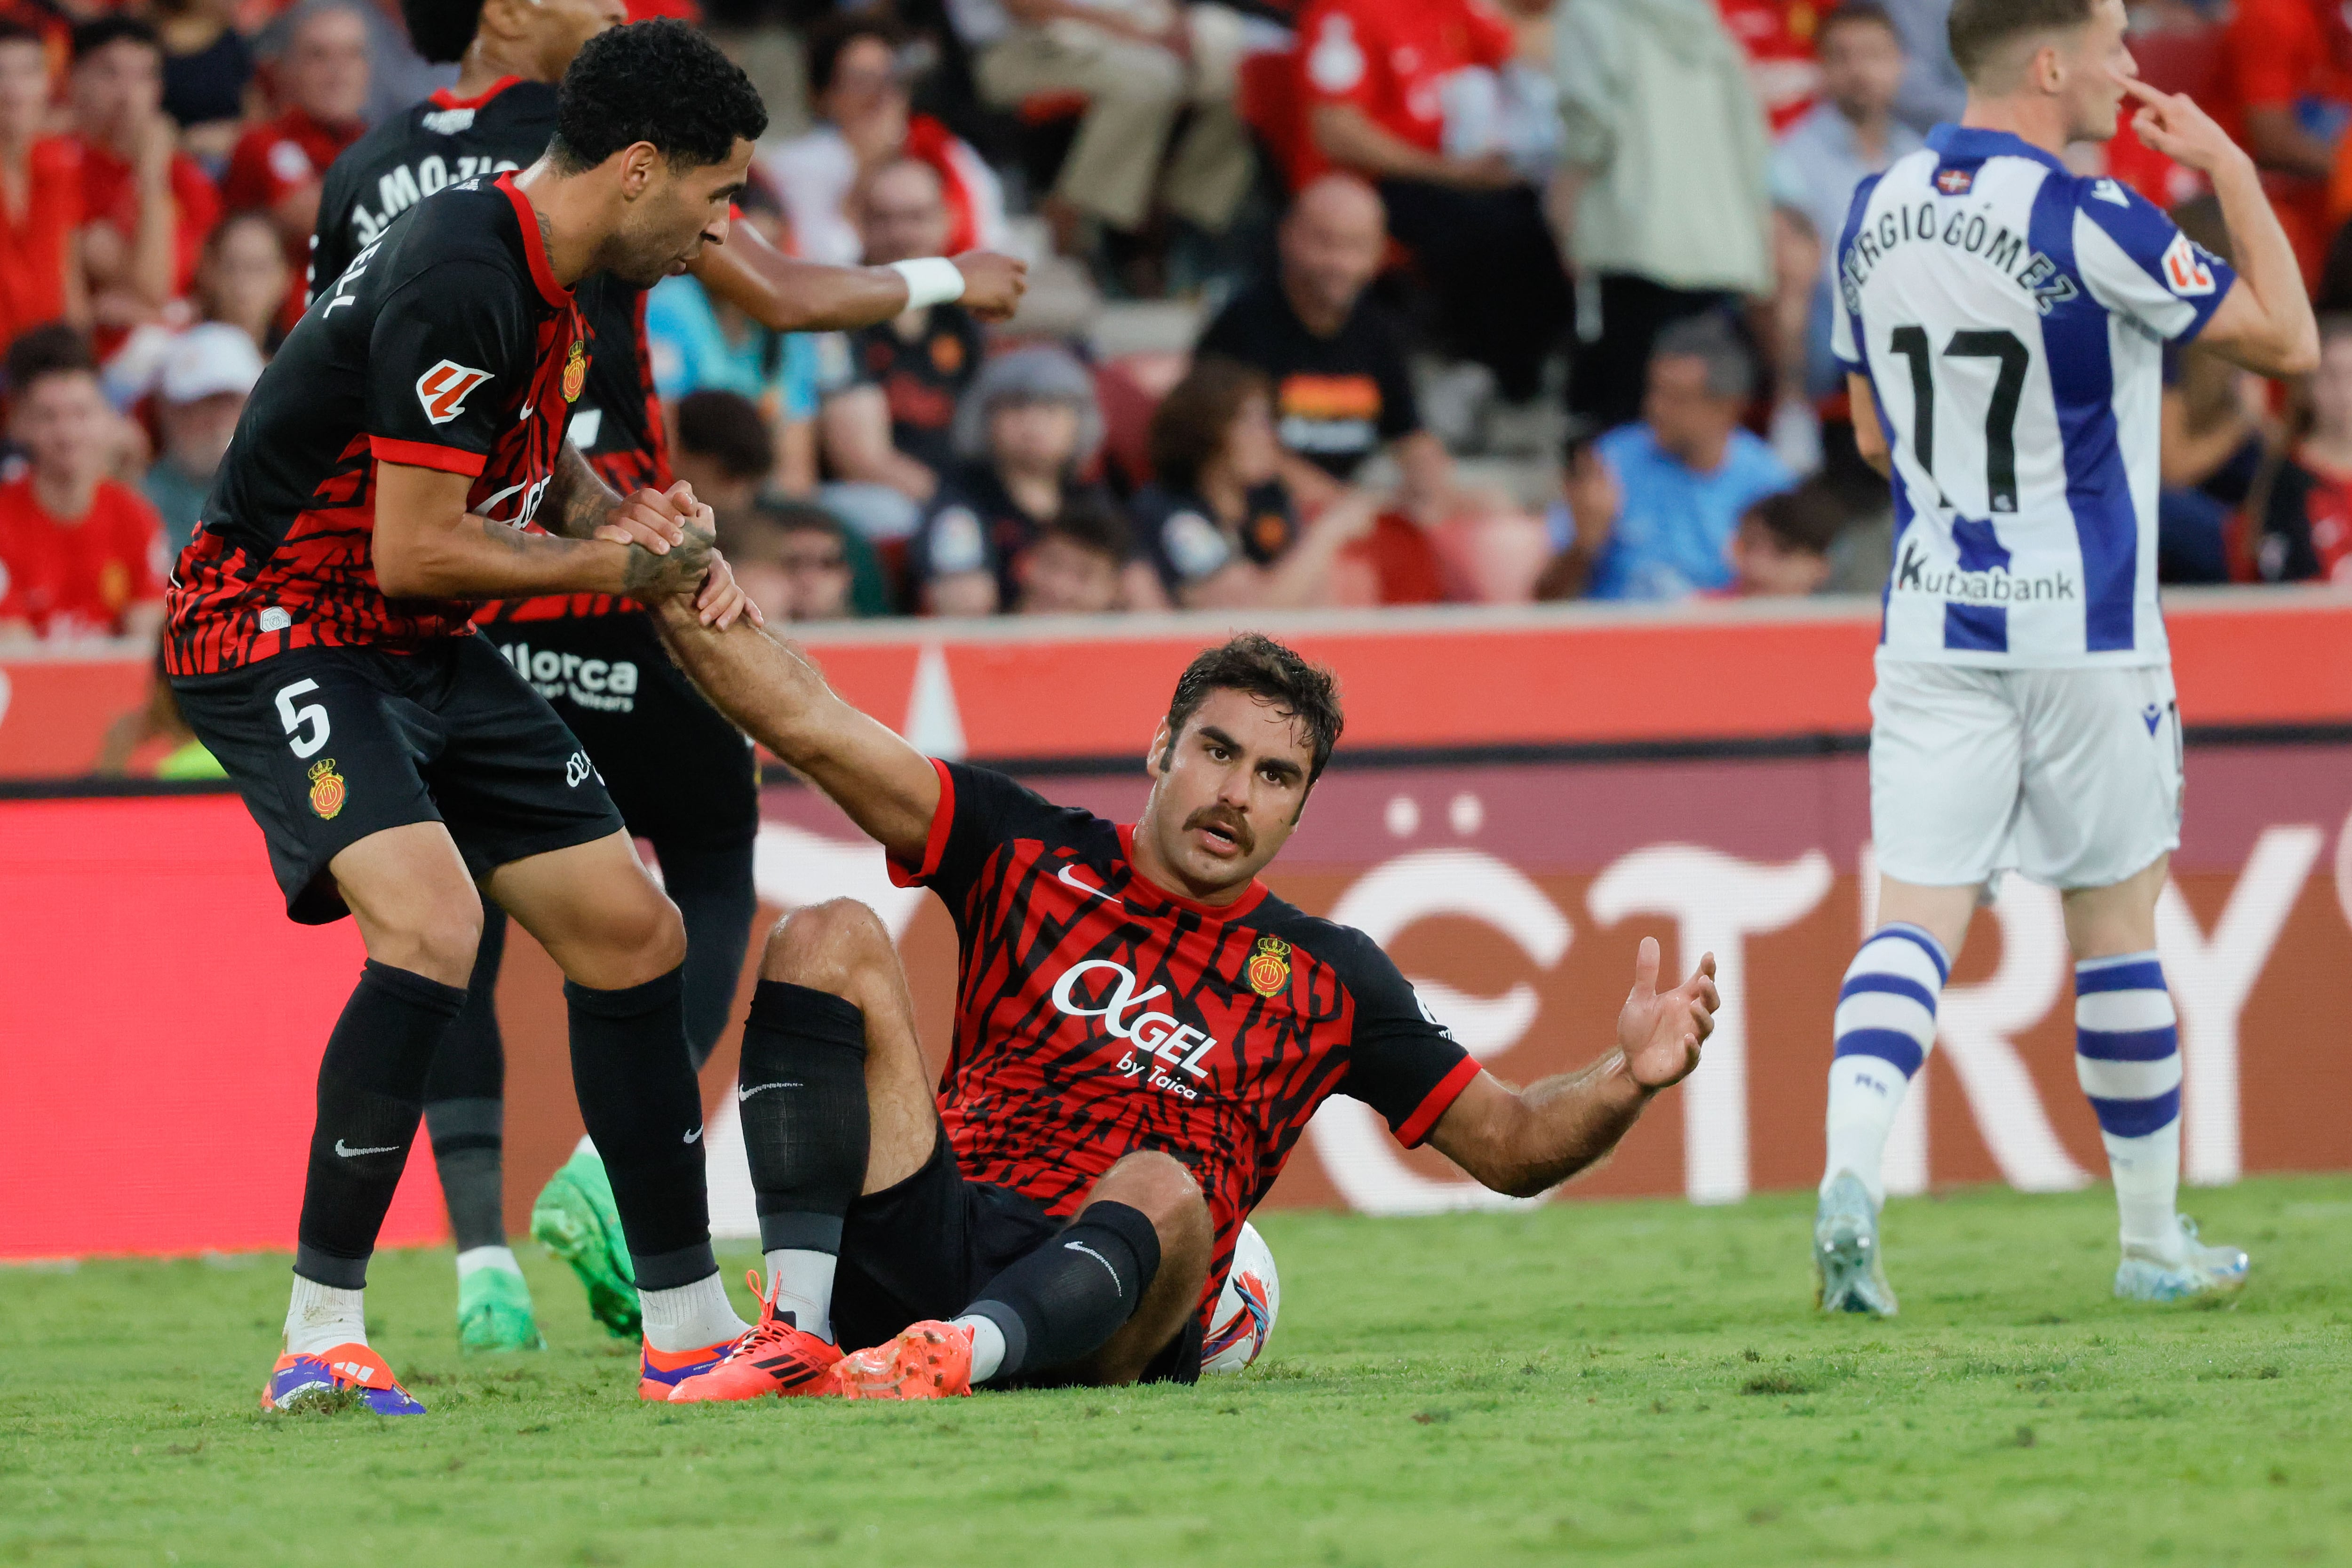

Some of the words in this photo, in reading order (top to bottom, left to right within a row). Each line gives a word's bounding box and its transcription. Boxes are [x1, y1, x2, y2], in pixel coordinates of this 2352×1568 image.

[1890, 326, 2030, 513] 17
[1898, 538, 2075, 600] Kutxabank
[275, 678, 331, 759] 5
[1116, 1051, 1145, 1078] by
[1147, 1065, 1198, 1099] Taica
